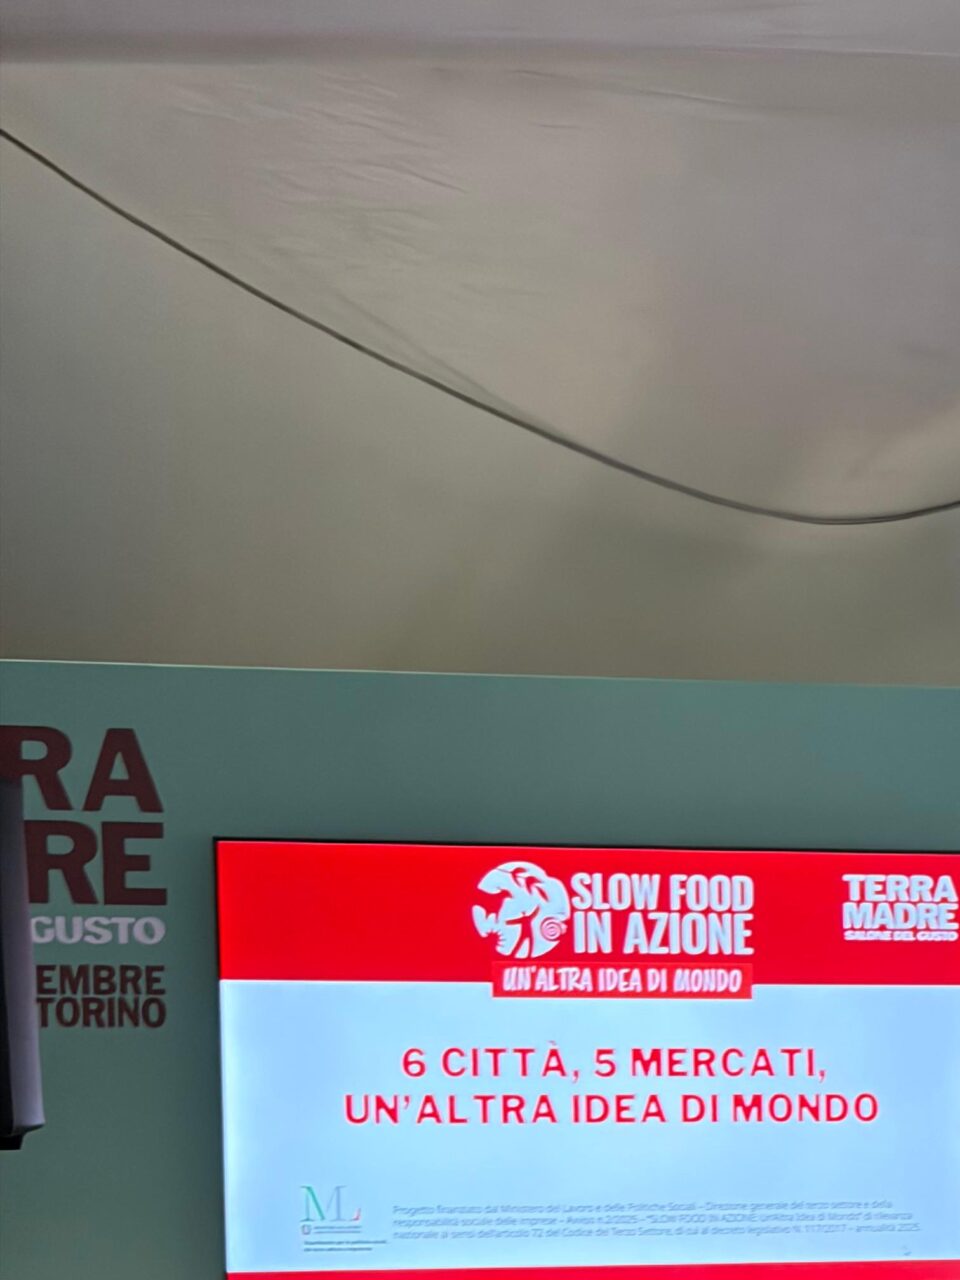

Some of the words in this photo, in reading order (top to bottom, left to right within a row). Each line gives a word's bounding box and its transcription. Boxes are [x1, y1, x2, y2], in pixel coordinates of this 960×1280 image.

[24, 820, 167, 906] RE
[571, 872, 661, 911] SLOW
[670, 874, 754, 912] FOOD
[842, 874, 959, 902] TERRA
[30, 916, 166, 944] GUSTO
[842, 902, 960, 930] MADRE
[573, 911, 612, 953] IN
[623, 912, 754, 955] AZIONE
[36, 964, 166, 996] EMBRE
[502, 966, 592, 992] UN'ALTRA
[598, 967, 641, 993] IDEA
[647, 968, 667, 992] DI
[673, 969, 743, 993] MONDO
[37, 997, 166, 1029] TORINO
[402, 1048, 426, 1077] 6
[442, 1041, 580, 1084] CITTÀ,
[594, 1049, 616, 1077] 5
[631, 1048, 826, 1083] MERCATI,
[345, 1094, 557, 1124] UN’ALTRA
[572, 1094, 666, 1123] IDEA
[681, 1094, 718, 1123] DI
[733, 1093, 879, 1122] MONDO
